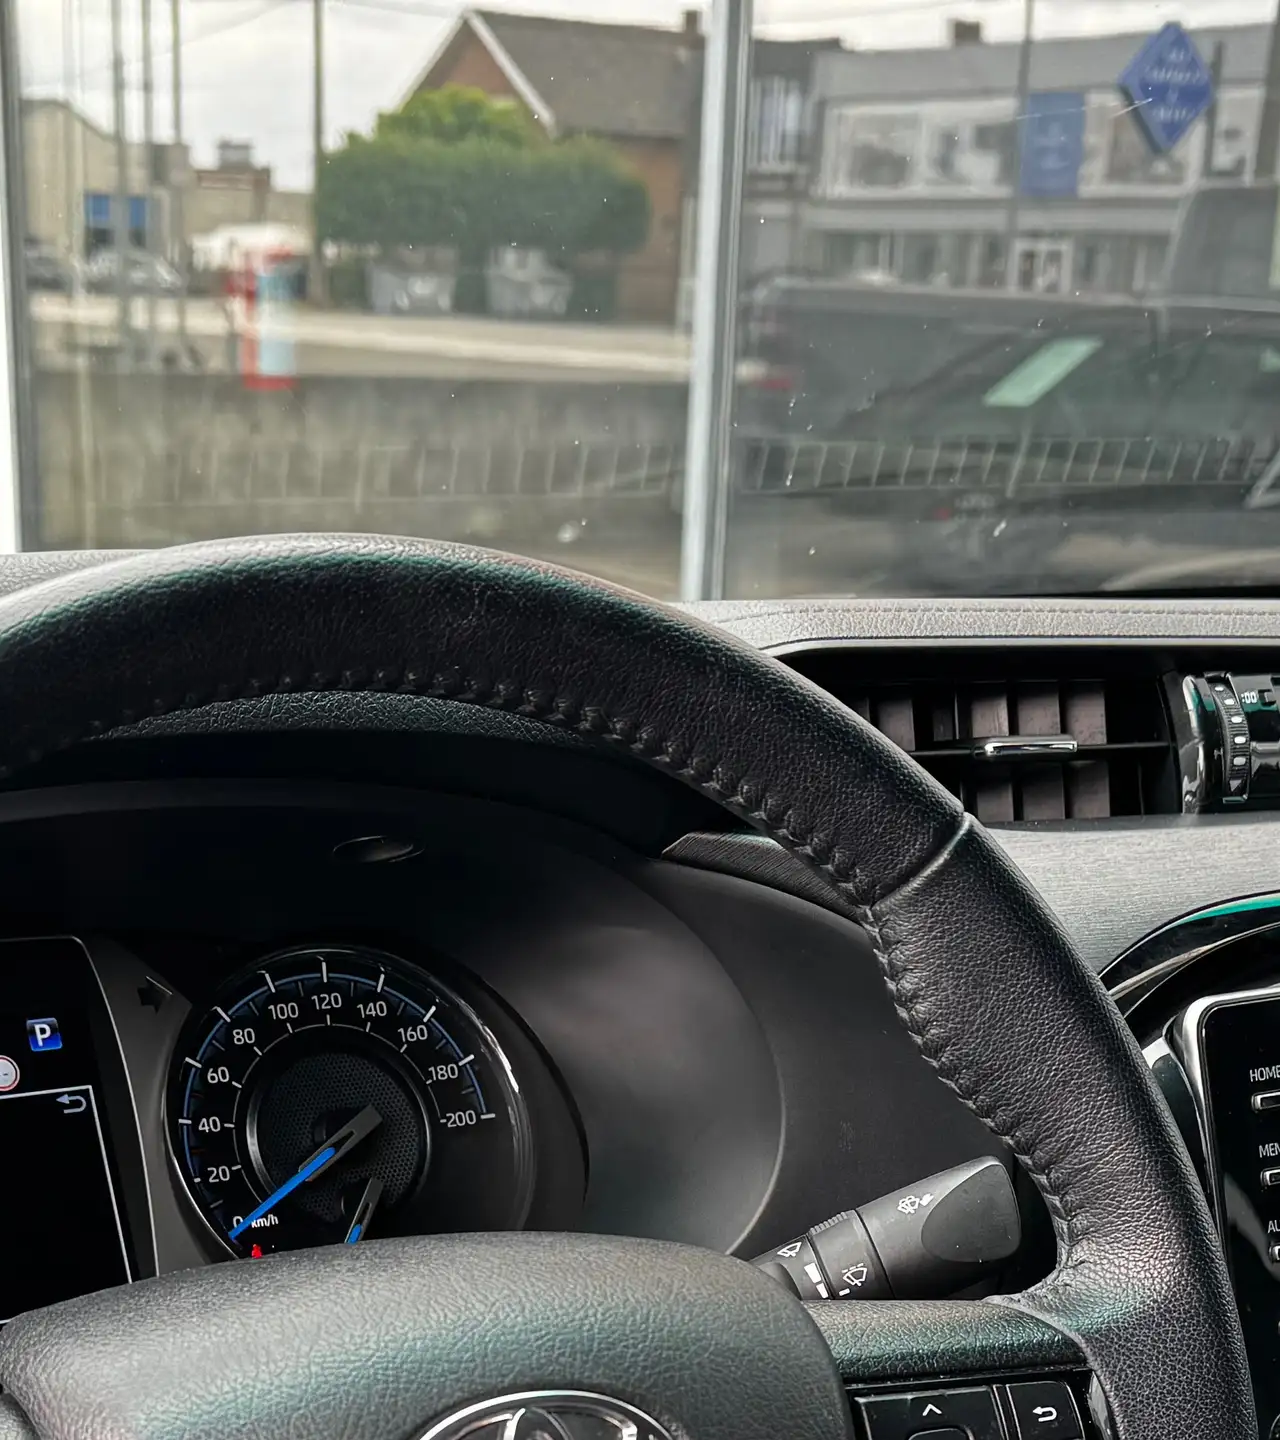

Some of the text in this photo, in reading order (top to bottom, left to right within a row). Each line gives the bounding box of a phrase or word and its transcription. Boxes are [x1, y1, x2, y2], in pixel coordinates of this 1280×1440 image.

[311, 992, 342, 1010] 120
[356, 1000, 388, 1019] 140
[267, 1002, 299, 1020] 100
[33, 1023, 54, 1047] P
[233, 1027, 256, 1046] 80
[397, 1024, 429, 1043] 160
[206, 1066, 230, 1084] 60
[429, 1063, 459, 1082] 180
[198, 1115, 221, 1134] 40
[208, 1166, 231, 1183] 20
[251, 1213, 279, 1228] km/h
